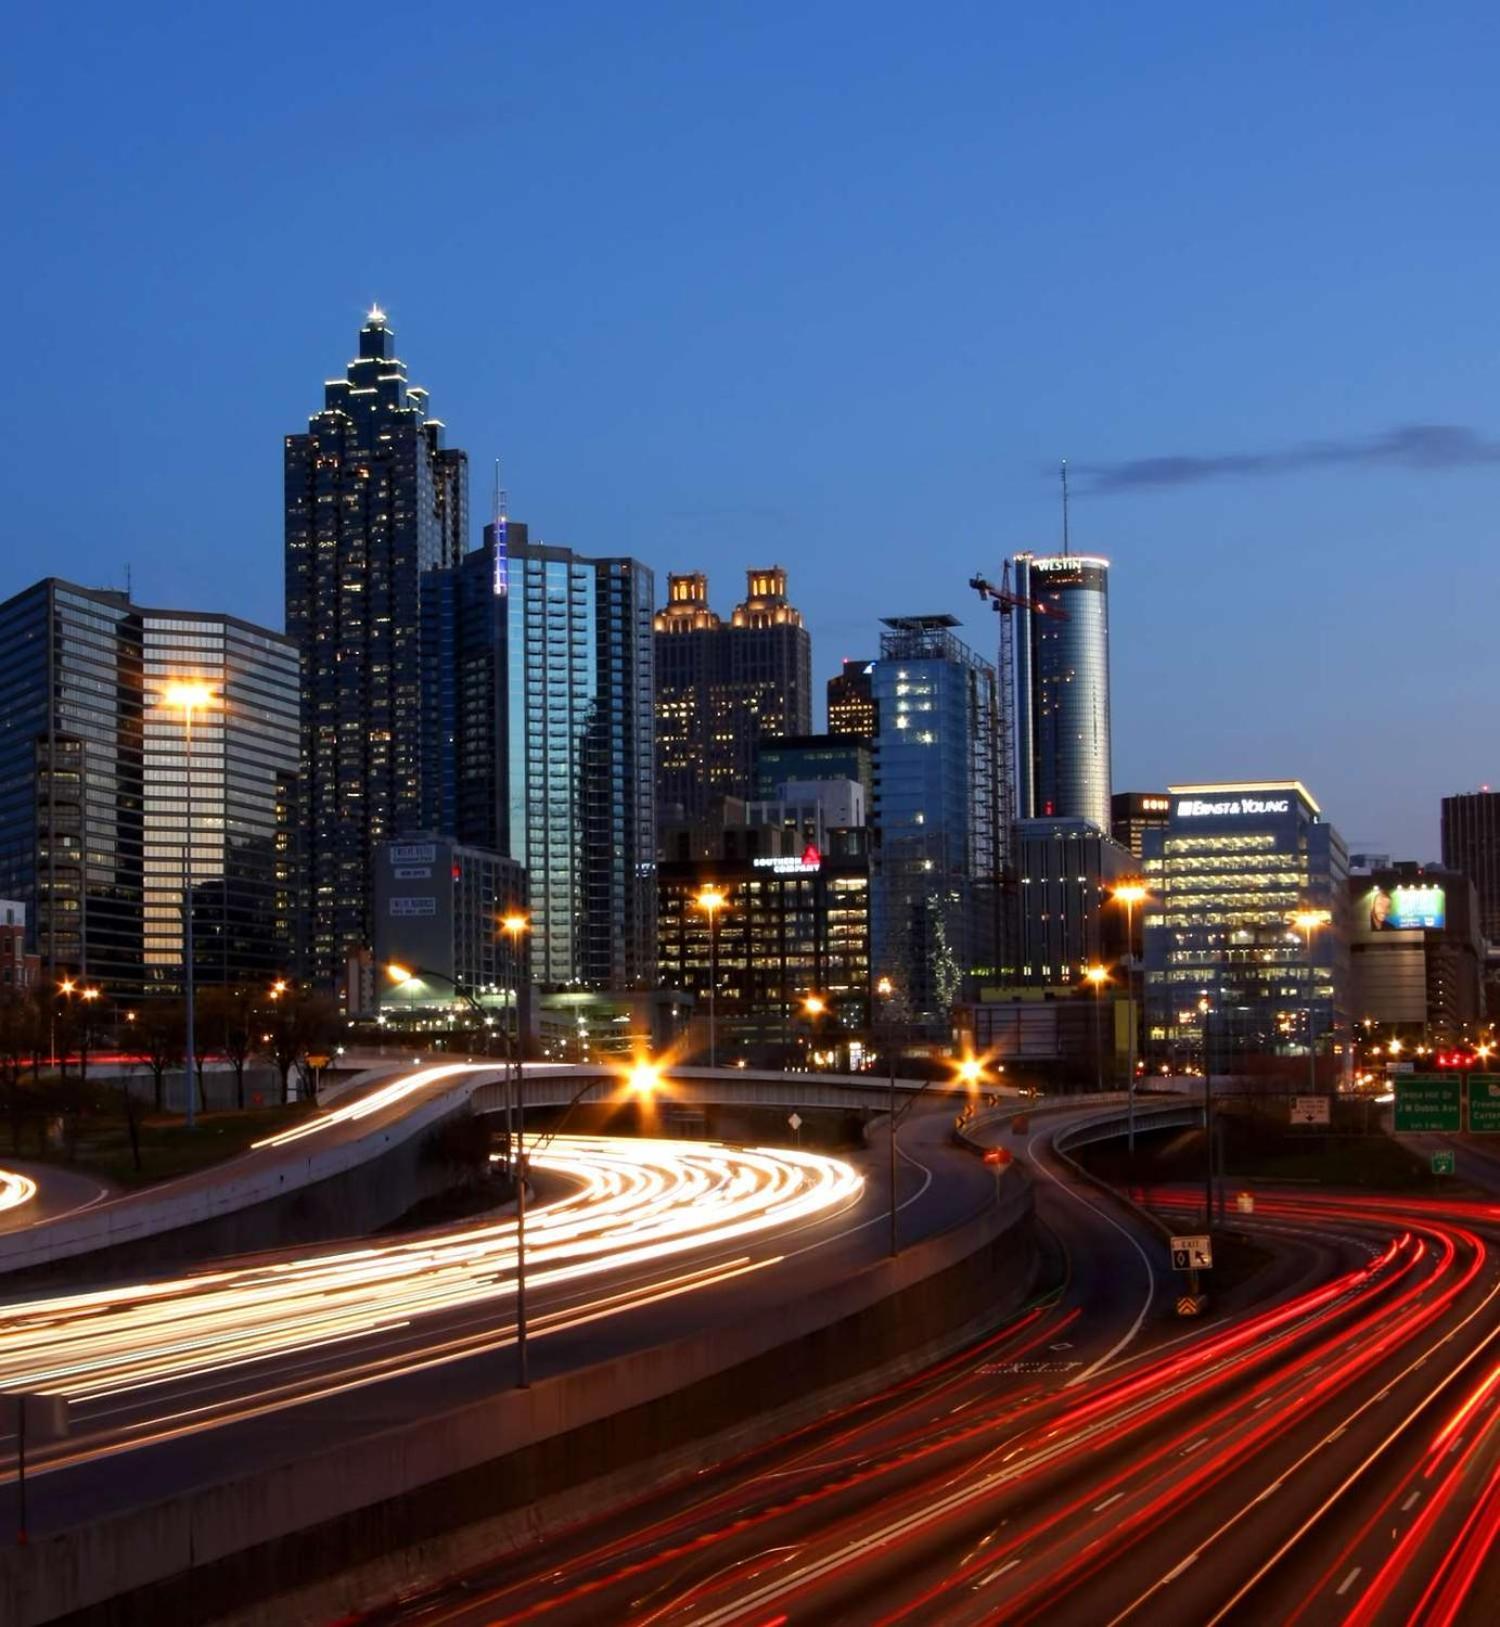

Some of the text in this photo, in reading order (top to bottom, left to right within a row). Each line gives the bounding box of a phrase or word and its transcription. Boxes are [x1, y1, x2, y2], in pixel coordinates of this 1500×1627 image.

[1038, 558, 1081, 571] WESTIN
[1230, 802, 1240, 814] &
[1241, 799, 1289, 814] YOUNG
[753, 857, 802, 867] SOUTHERN
[774, 863, 820, 873] COMPANY
